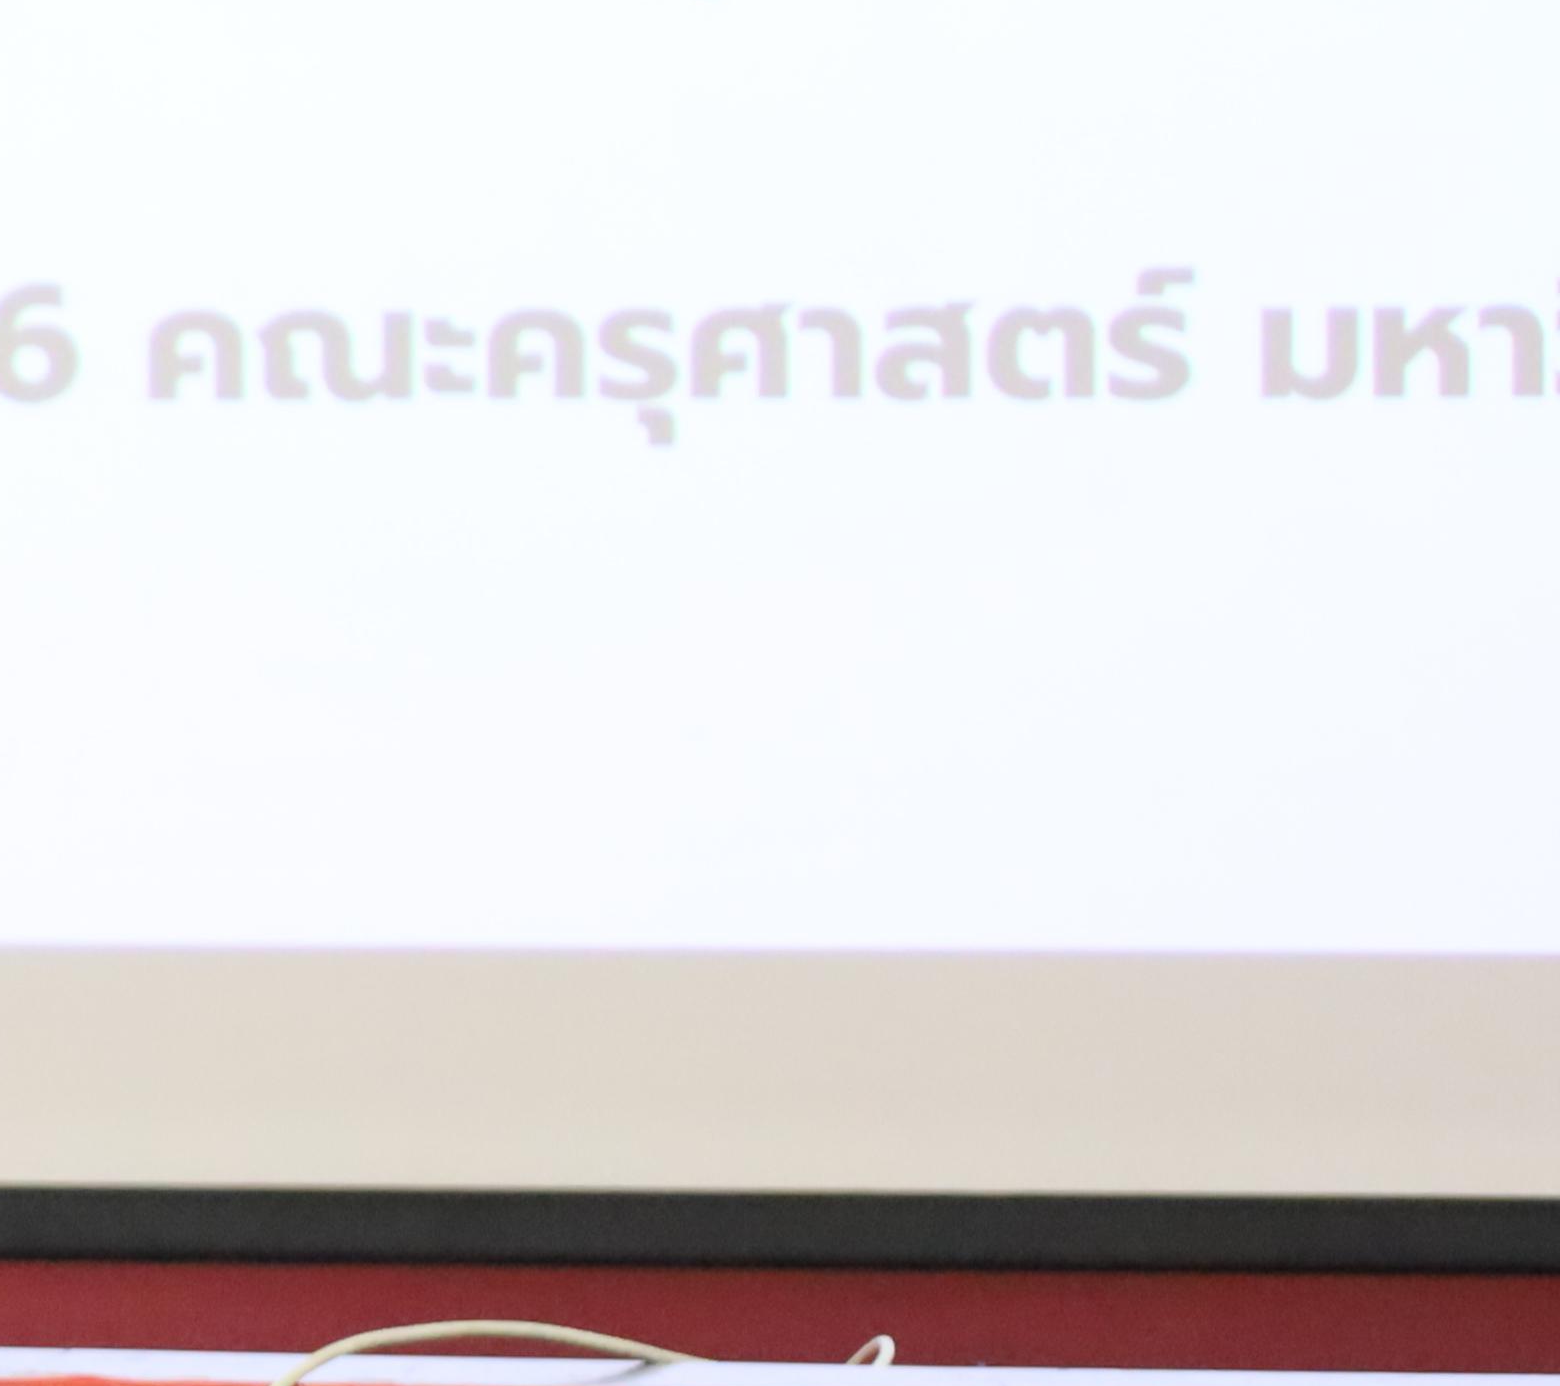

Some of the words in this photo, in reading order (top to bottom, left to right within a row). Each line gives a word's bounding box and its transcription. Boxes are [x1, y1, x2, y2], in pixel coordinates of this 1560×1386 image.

[149, 267, 1197, 447] คณะครุศาสตร์
[1261, 277, 1560, 402] มหา
